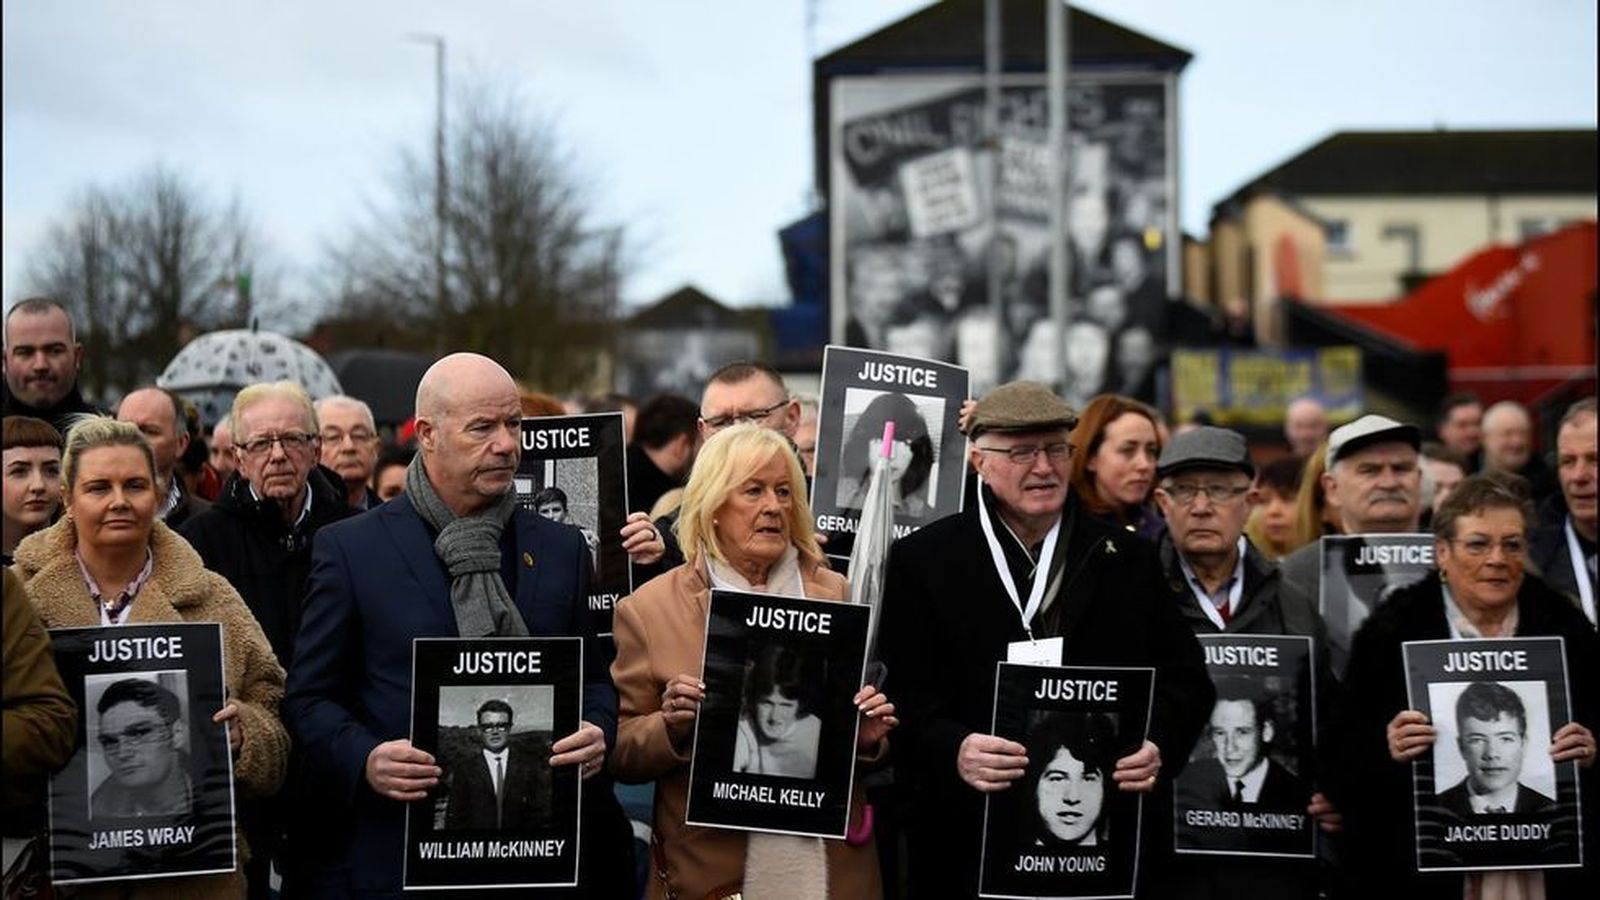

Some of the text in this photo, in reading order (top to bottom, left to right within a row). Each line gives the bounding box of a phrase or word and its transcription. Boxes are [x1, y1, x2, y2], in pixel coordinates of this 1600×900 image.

[858, 361, 938, 388] JUSTICE
[522, 427, 590, 450] USTICE
[1354, 545, 1434, 565] JUSTICE
[746, 606, 832, 634] JUSTICE
[88, 636, 184, 663] JUSTICE
[1204, 645, 1279, 667] JUSTICE
[453, 651, 542, 674] JUSTICE
[1443, 650, 1529, 673] JUSTICE
[1035, 678, 1118, 702] JUSTICE
[713, 782, 825, 809] MICHAEL KELLY
[1186, 809, 1306, 831] GERARD McKINNEY
[88, 825, 196, 850] JAMES WRAY
[1444, 823, 1552, 842] JACKIE DUDDY
[419, 838, 566, 860] WILLIAM McKINNEY
[1014, 855, 1107, 873] JOHN YOUNG
